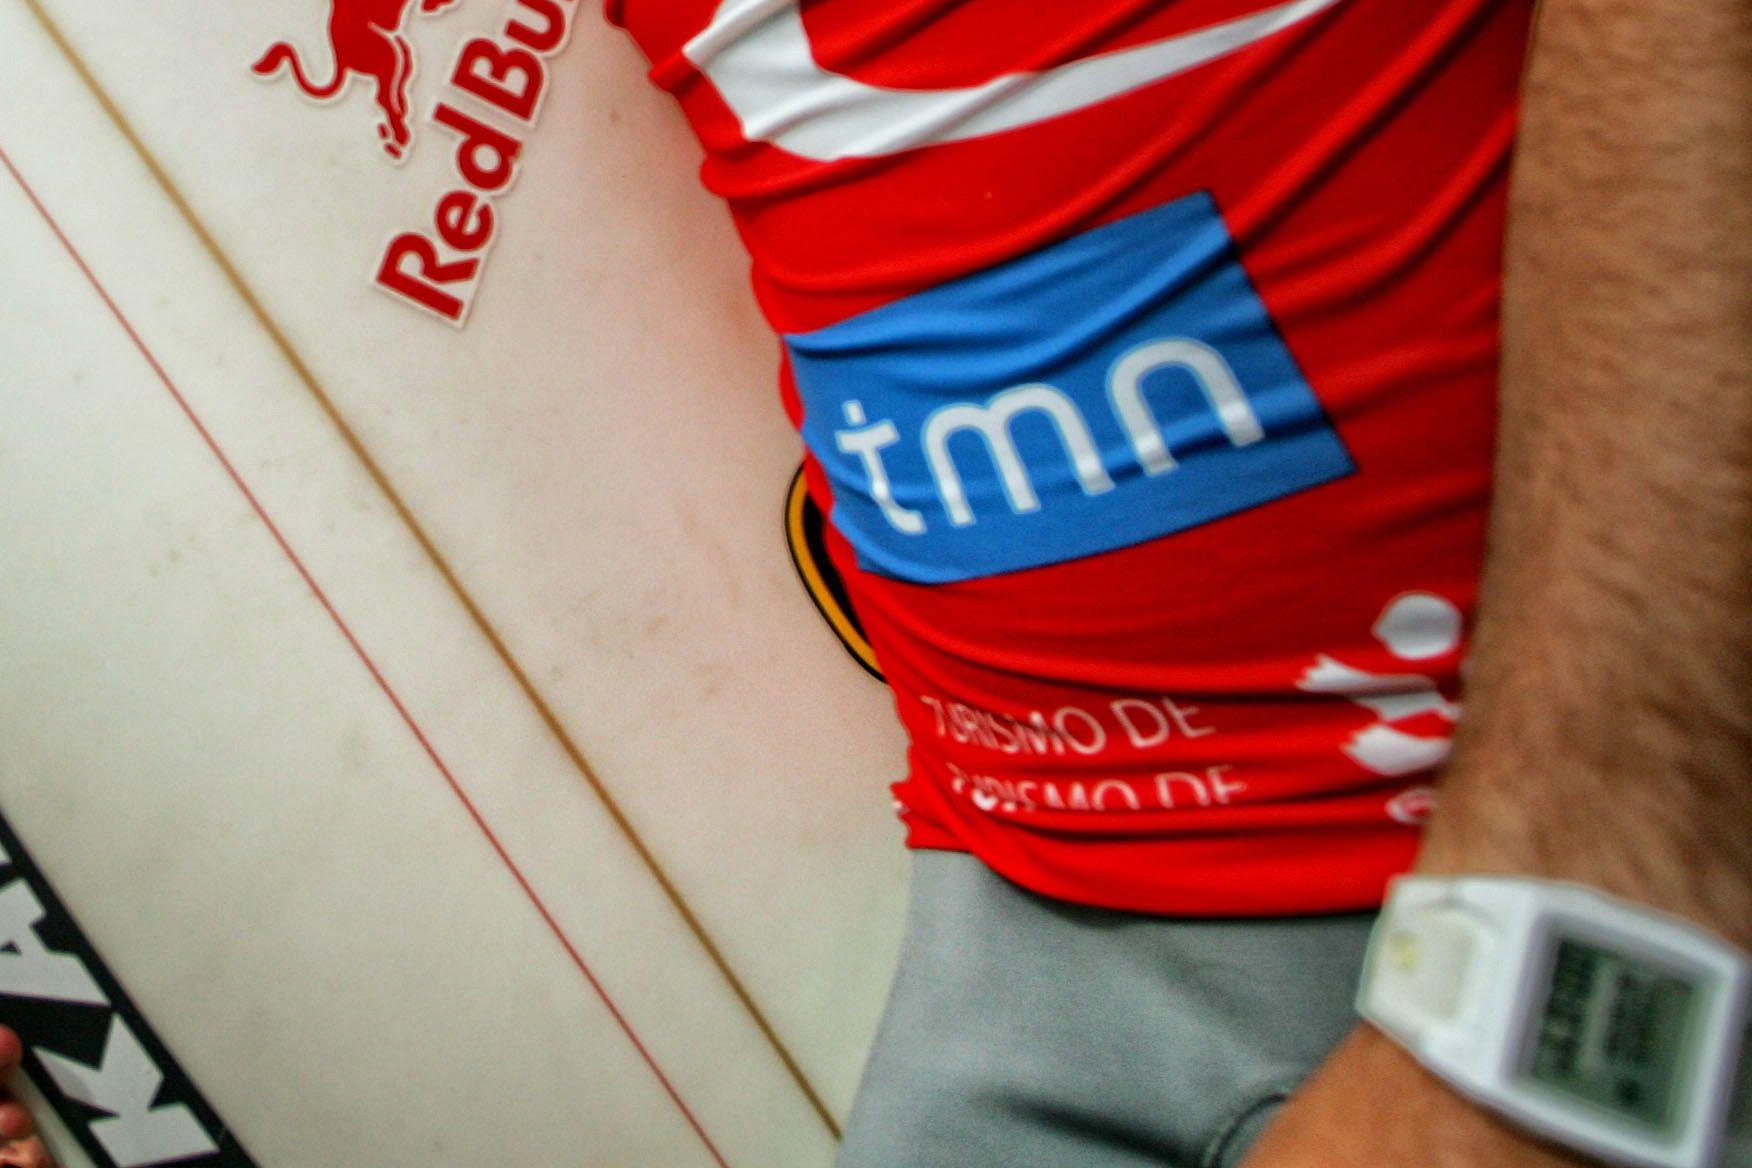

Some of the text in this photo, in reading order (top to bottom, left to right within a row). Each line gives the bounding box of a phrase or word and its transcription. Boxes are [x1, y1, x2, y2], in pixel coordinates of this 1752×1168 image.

[375, 101, 524, 323] Red
[834, 337, 1265, 534] tmn
[1109, 695, 1217, 749] DE
